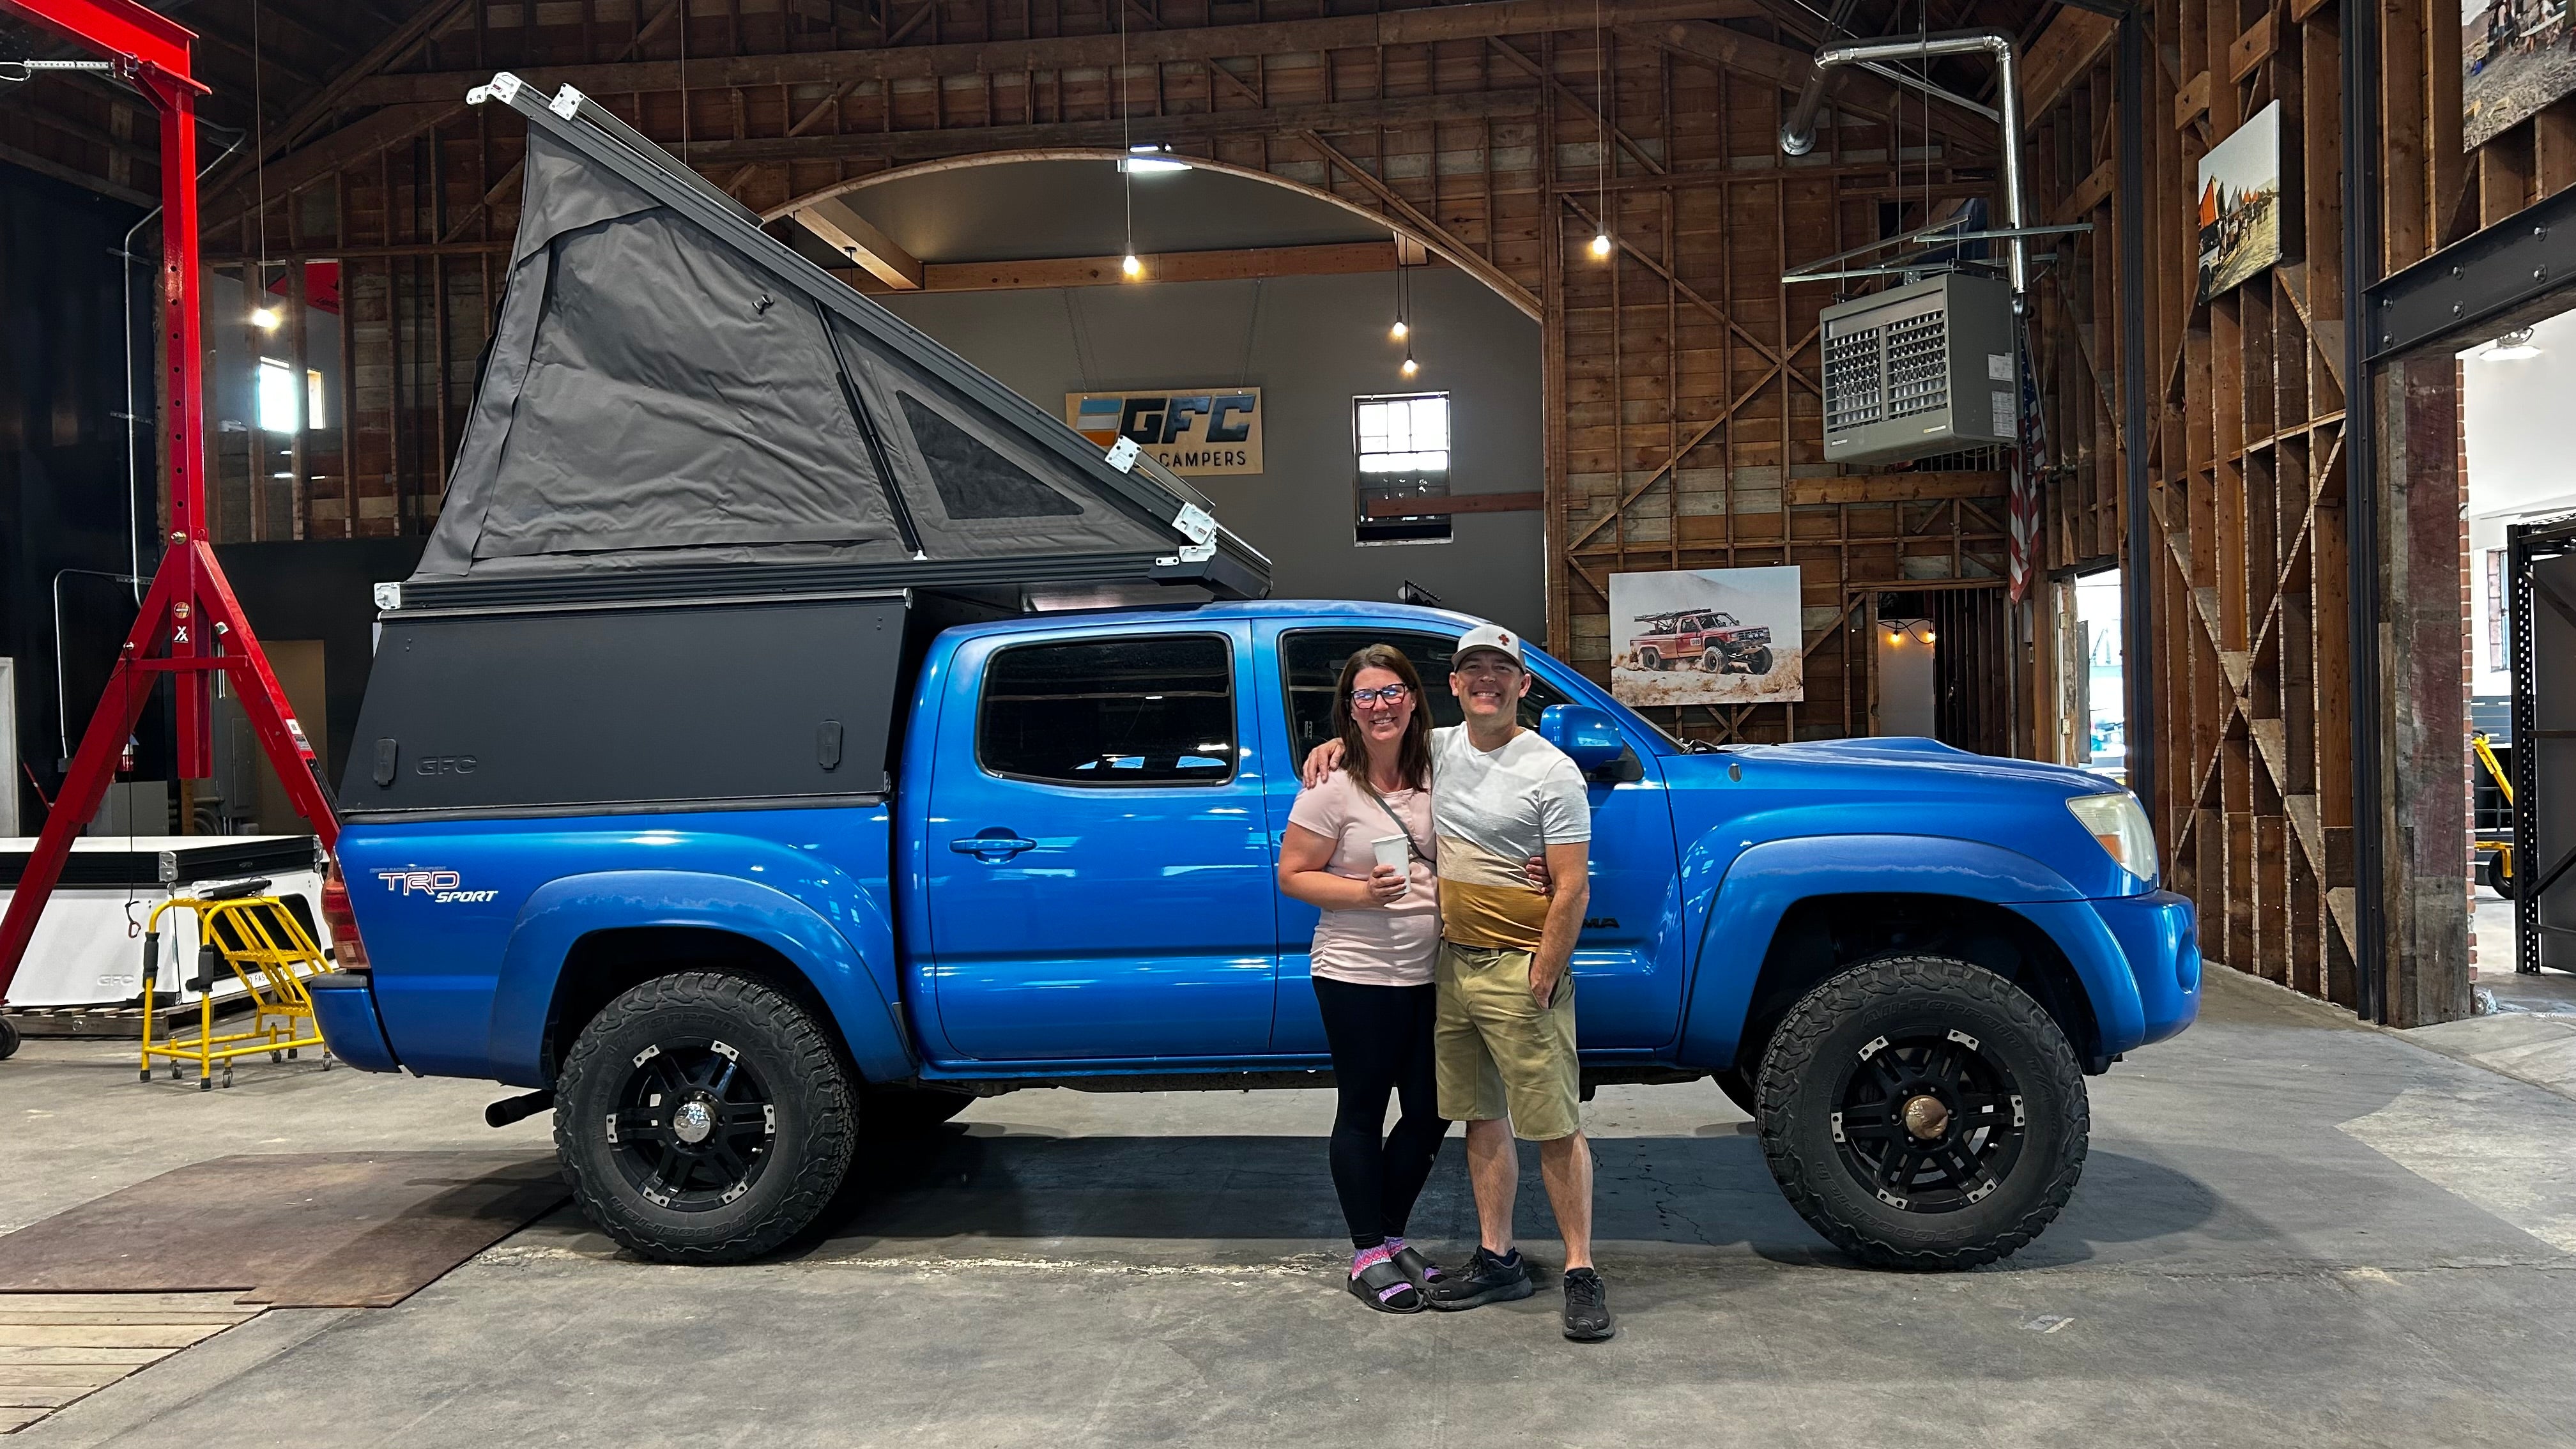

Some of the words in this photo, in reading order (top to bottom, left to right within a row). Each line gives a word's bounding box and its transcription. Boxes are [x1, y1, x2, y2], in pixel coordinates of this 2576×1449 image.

[1119, 394, 1256, 445] GFC
[1159, 450, 1246, 467] CAMPERS
[416, 755, 478, 776] GFC
[378, 871, 460, 896] TRD
[435, 890, 498, 903] SPORT
[97, 974, 135, 986] GFC
[1862, 998, 2023, 1050] All-Terrain
